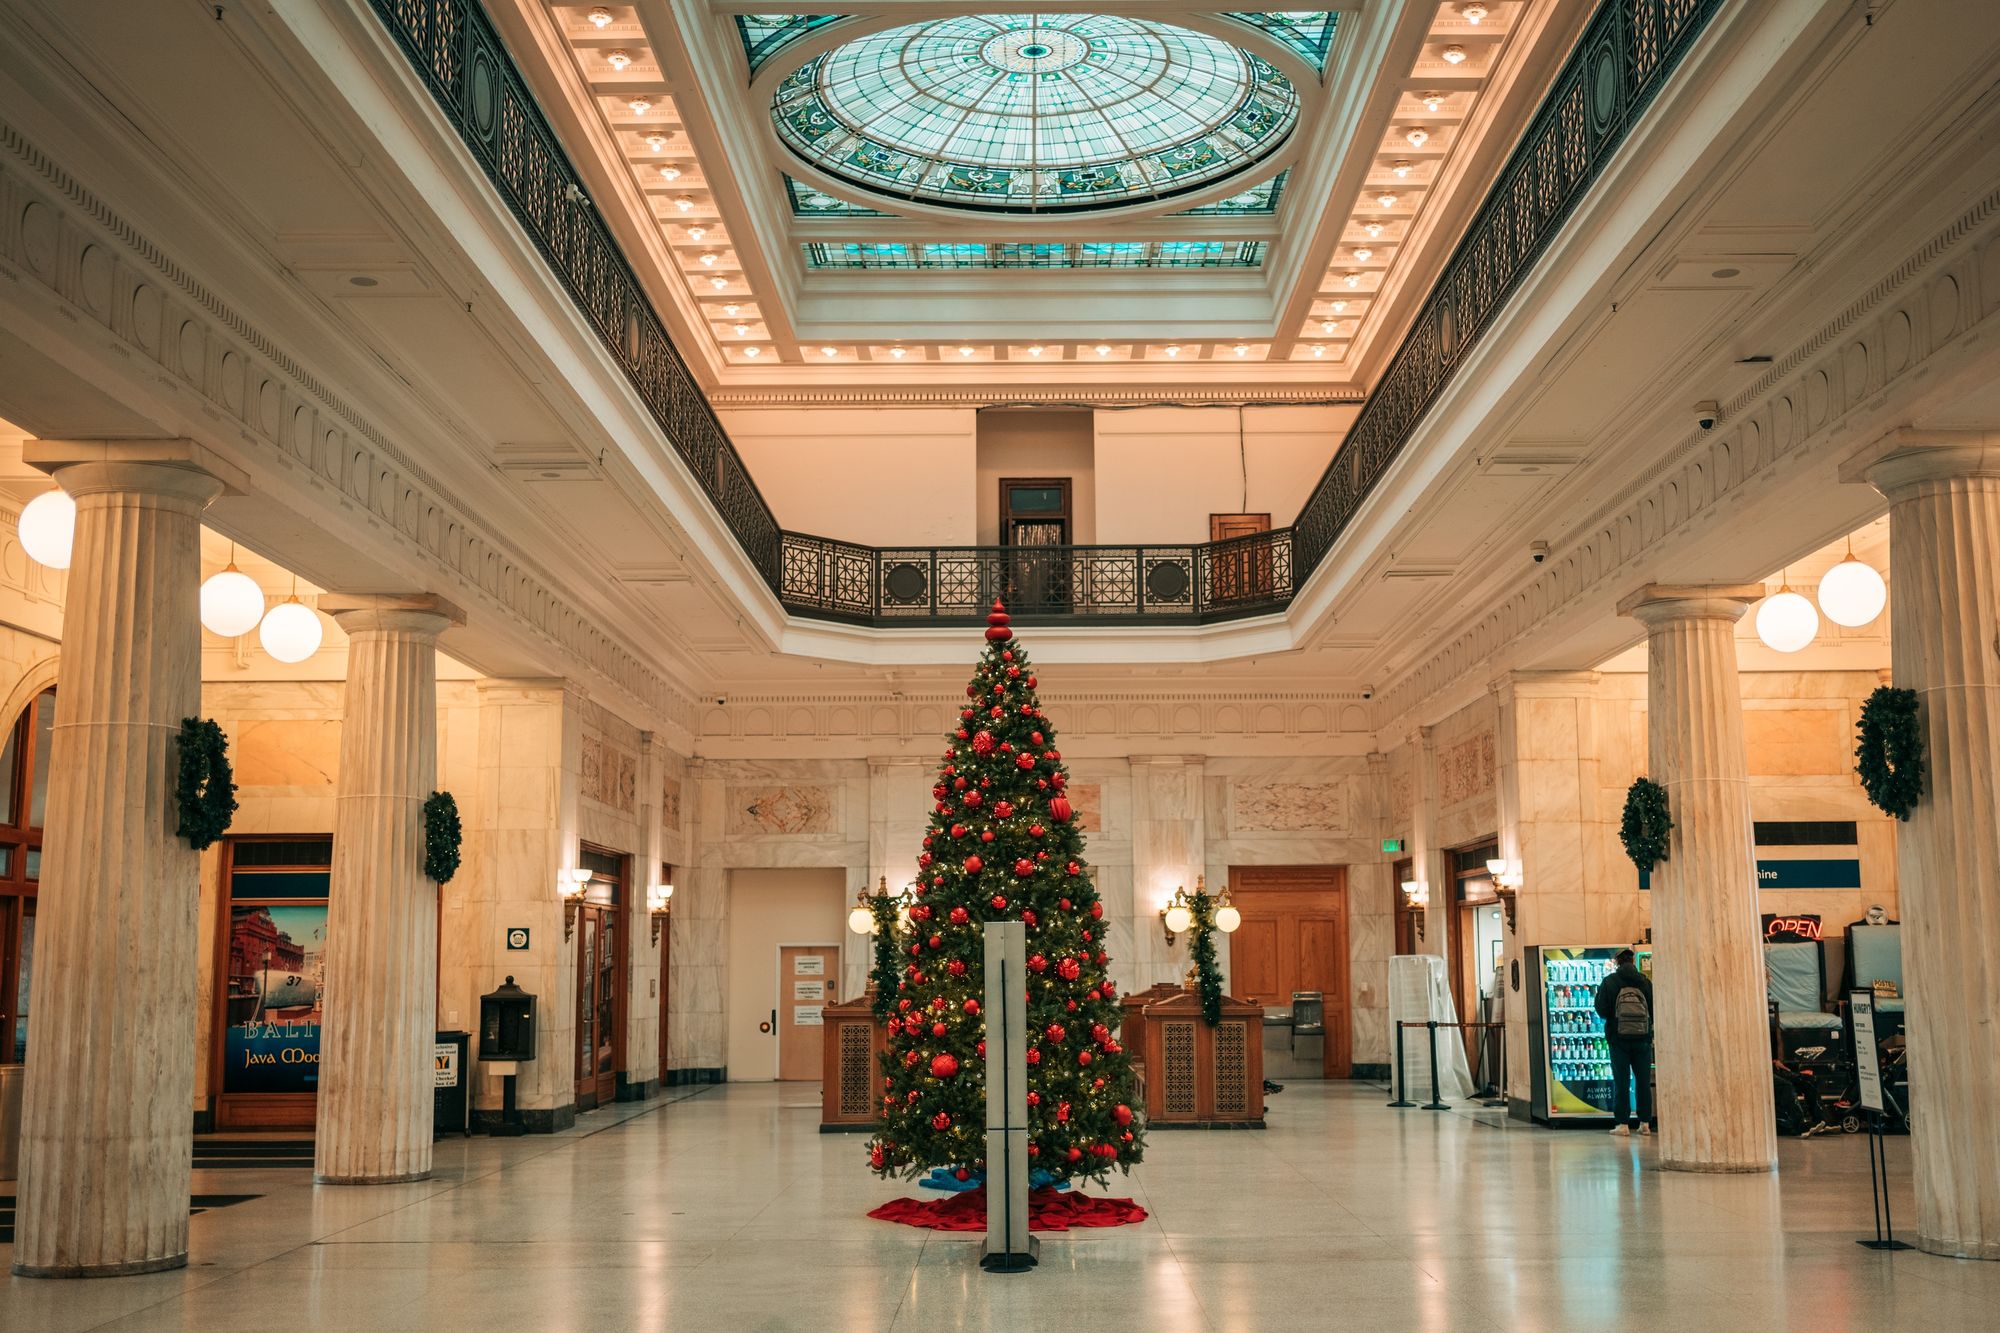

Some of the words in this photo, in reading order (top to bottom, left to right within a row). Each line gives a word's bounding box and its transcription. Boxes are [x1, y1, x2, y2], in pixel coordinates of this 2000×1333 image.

[1769, 919, 1823, 938] OPEN
[286, 975, 302, 987] 37
[245, 1049, 276, 1069] Java
